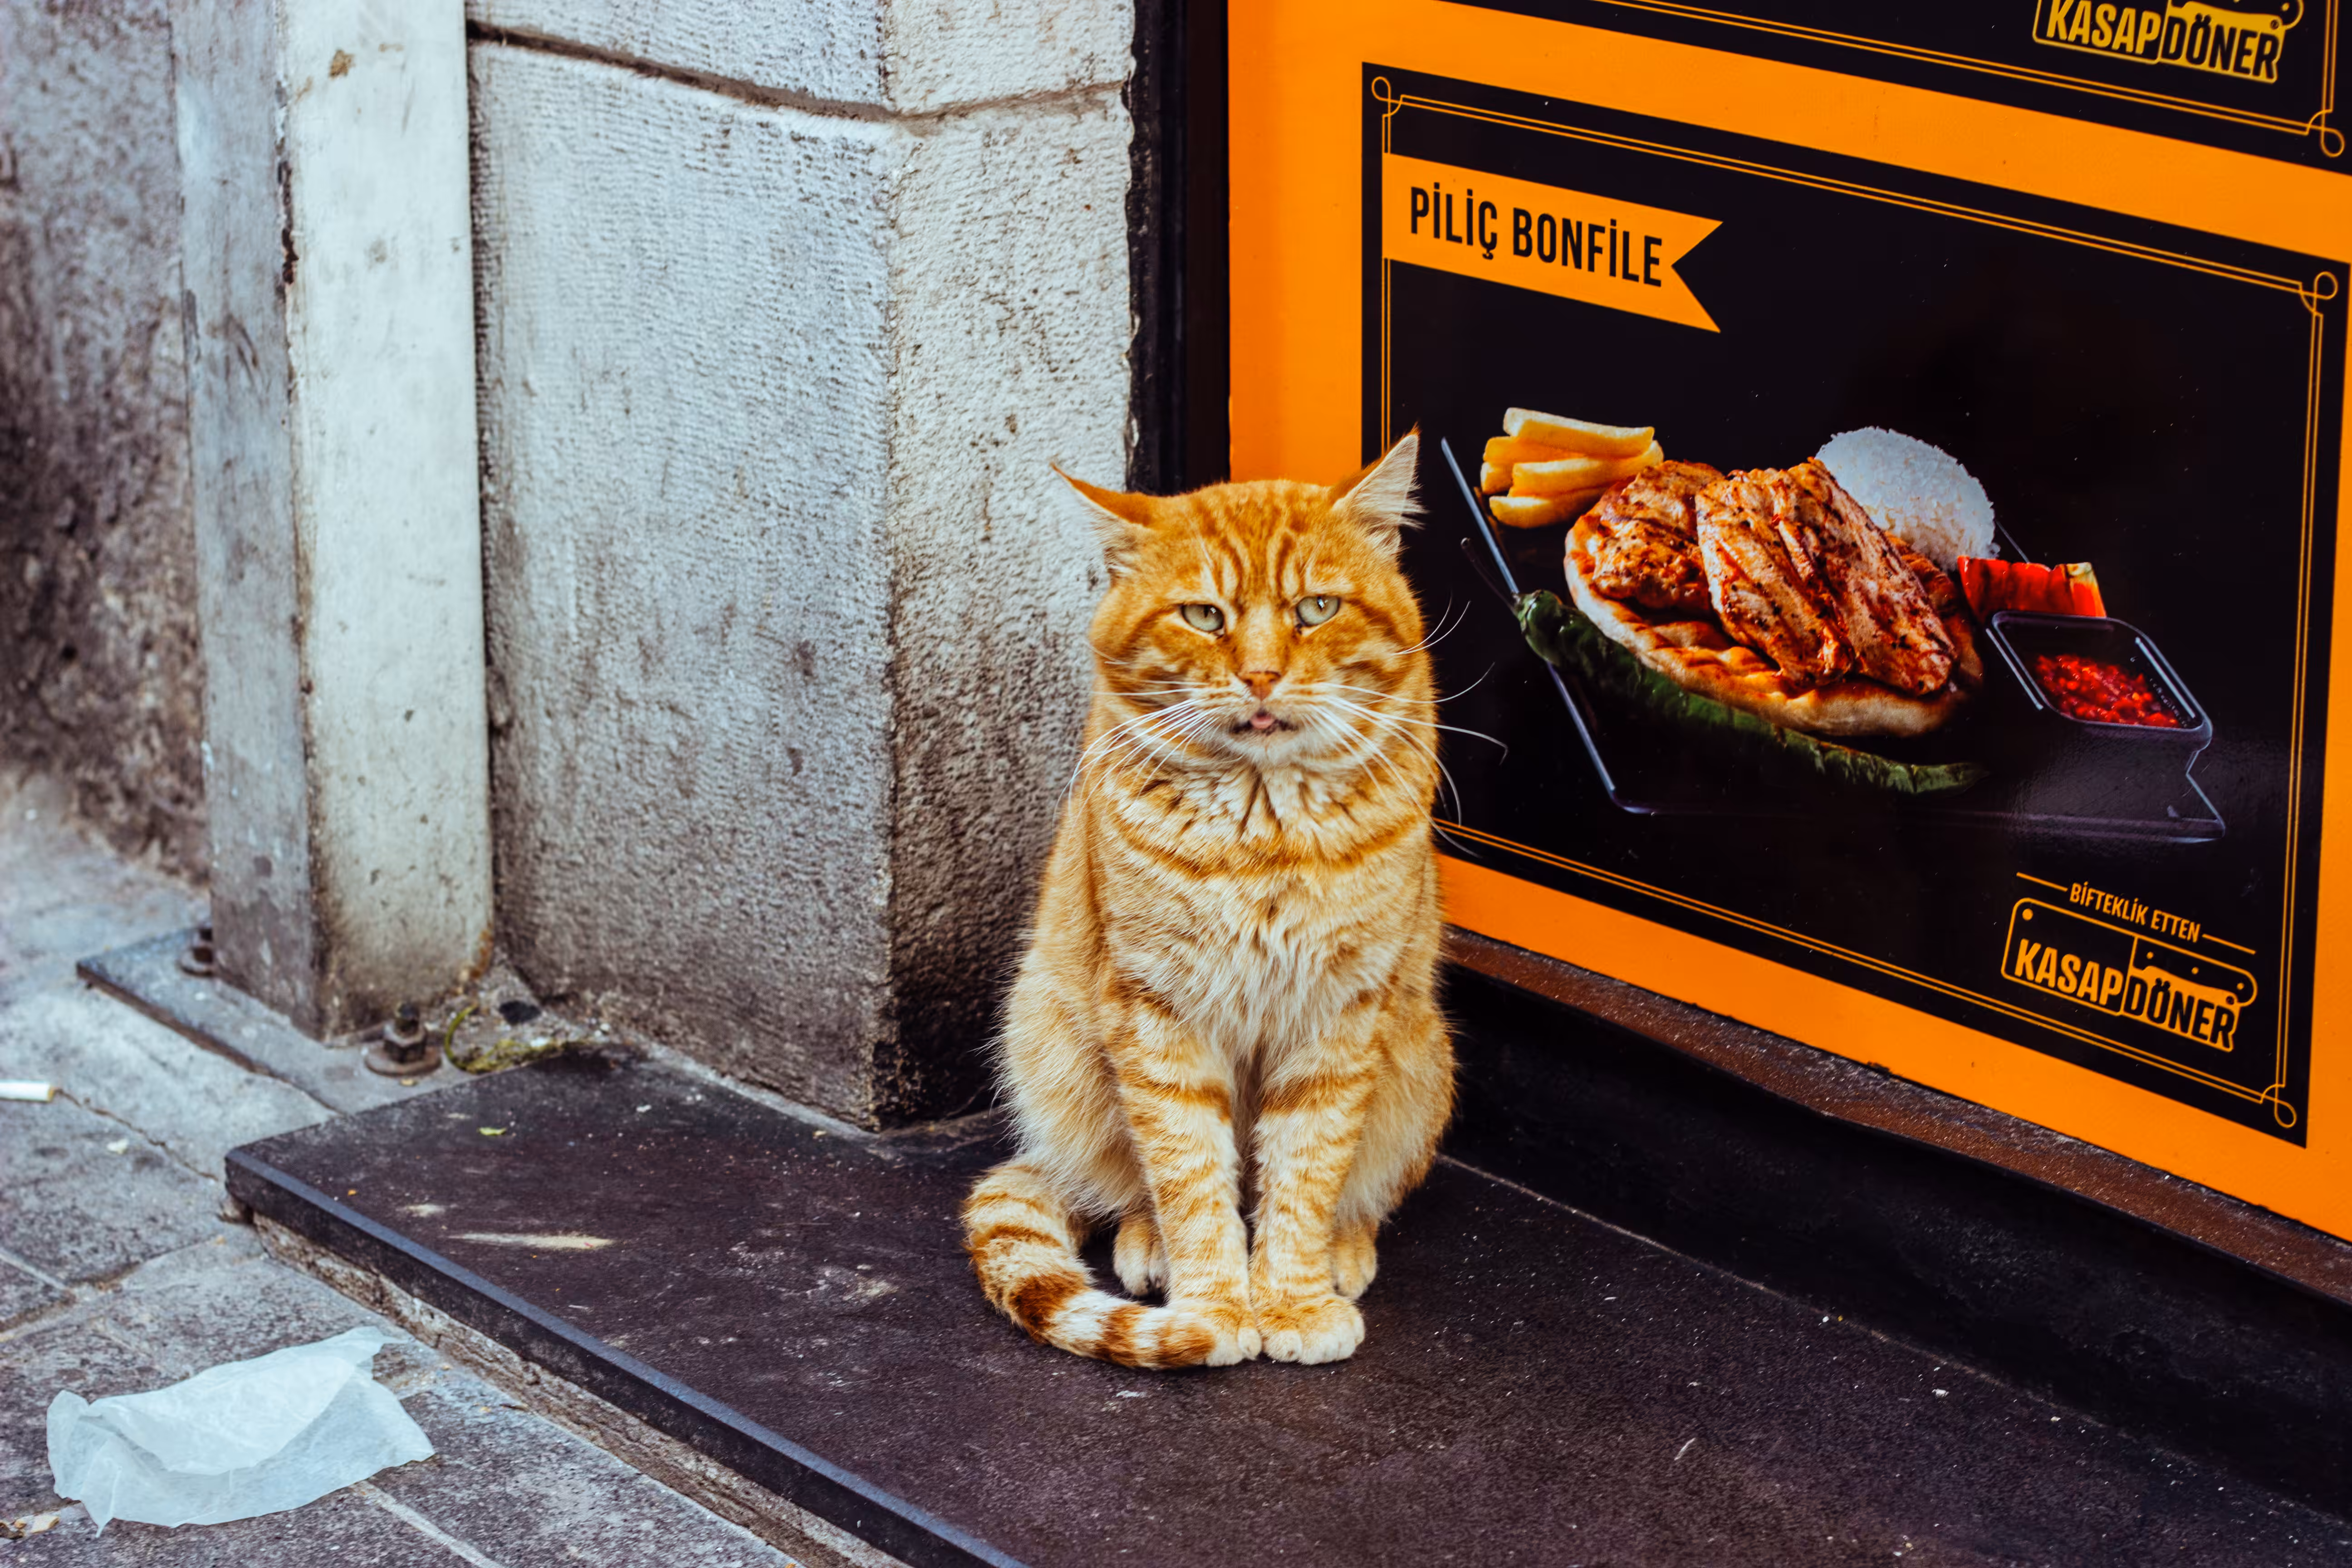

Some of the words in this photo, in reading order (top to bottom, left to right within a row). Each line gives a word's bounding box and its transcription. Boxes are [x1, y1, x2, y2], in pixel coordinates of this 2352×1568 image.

[1411, 182, 1498, 260] PİLİÇ
[1513, 207, 1662, 287] BONFİLE
[2069, 881, 2149, 926] BİFTEKLİK
[2151, 909, 2200, 943] ETTEN
